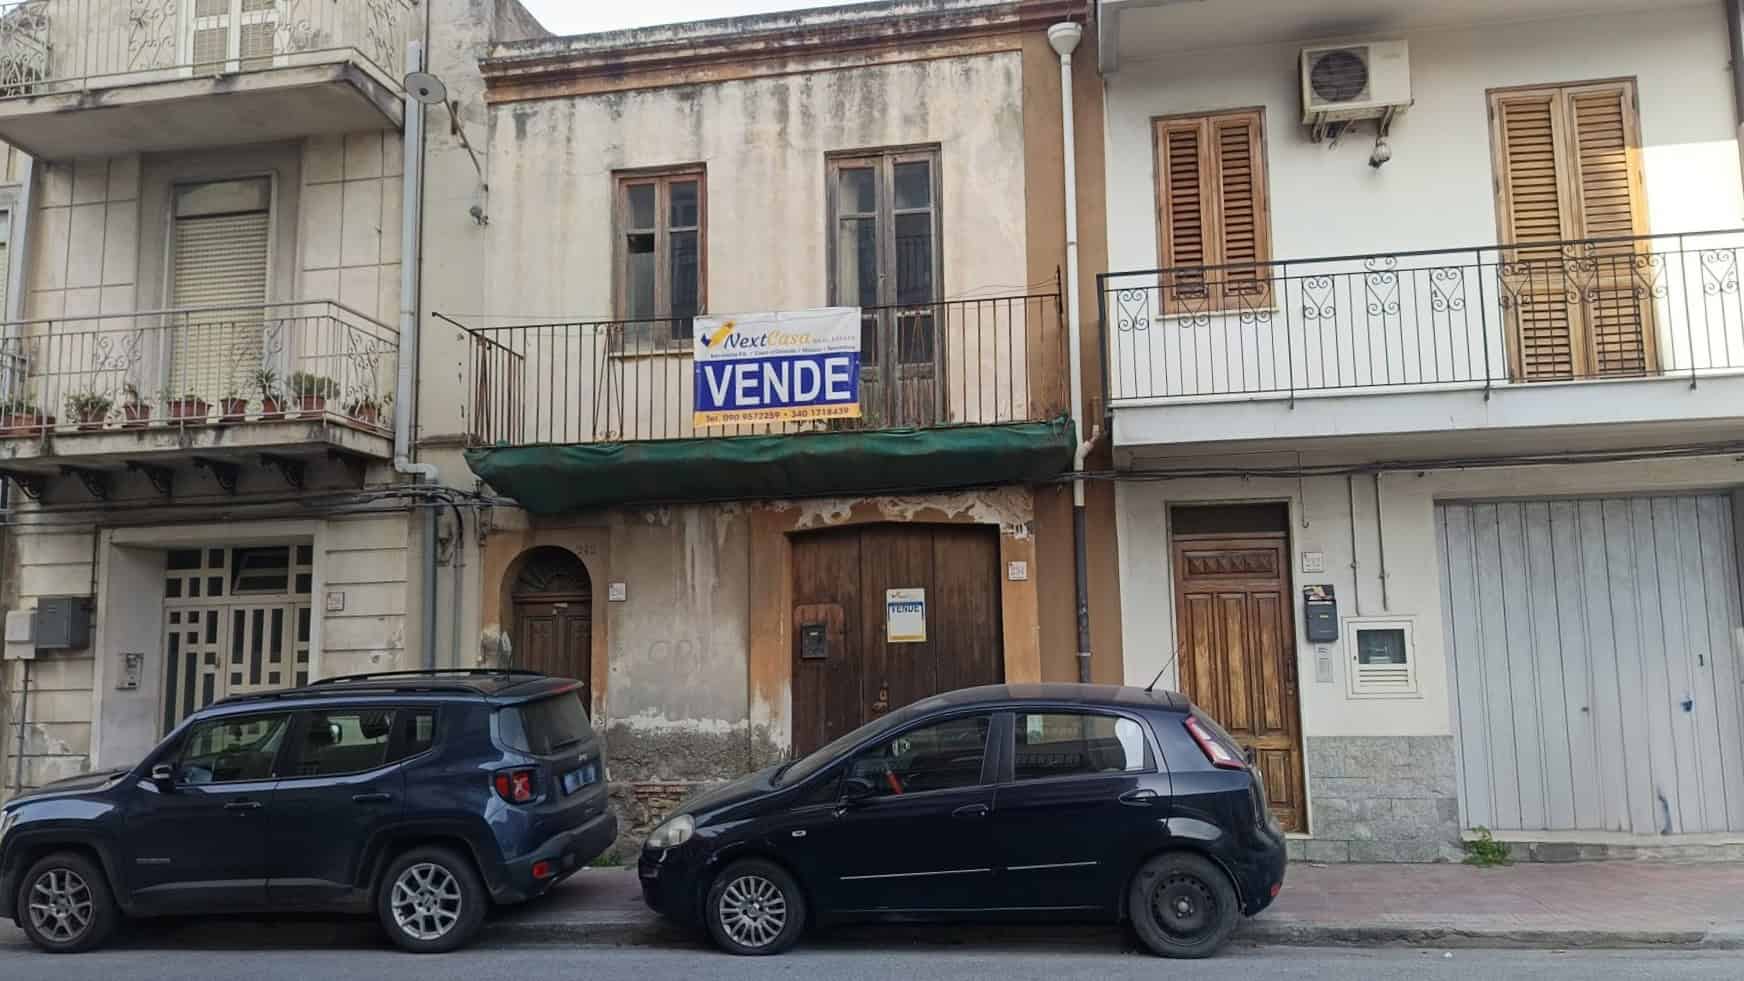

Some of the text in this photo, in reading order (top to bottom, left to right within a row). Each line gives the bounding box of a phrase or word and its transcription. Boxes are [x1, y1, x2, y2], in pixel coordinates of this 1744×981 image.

[724, 330, 811, 349] NextCasa
[704, 357, 851, 407] VENDE
[722, 413, 739, 422] 090
[791, 409, 808, 418] 340
